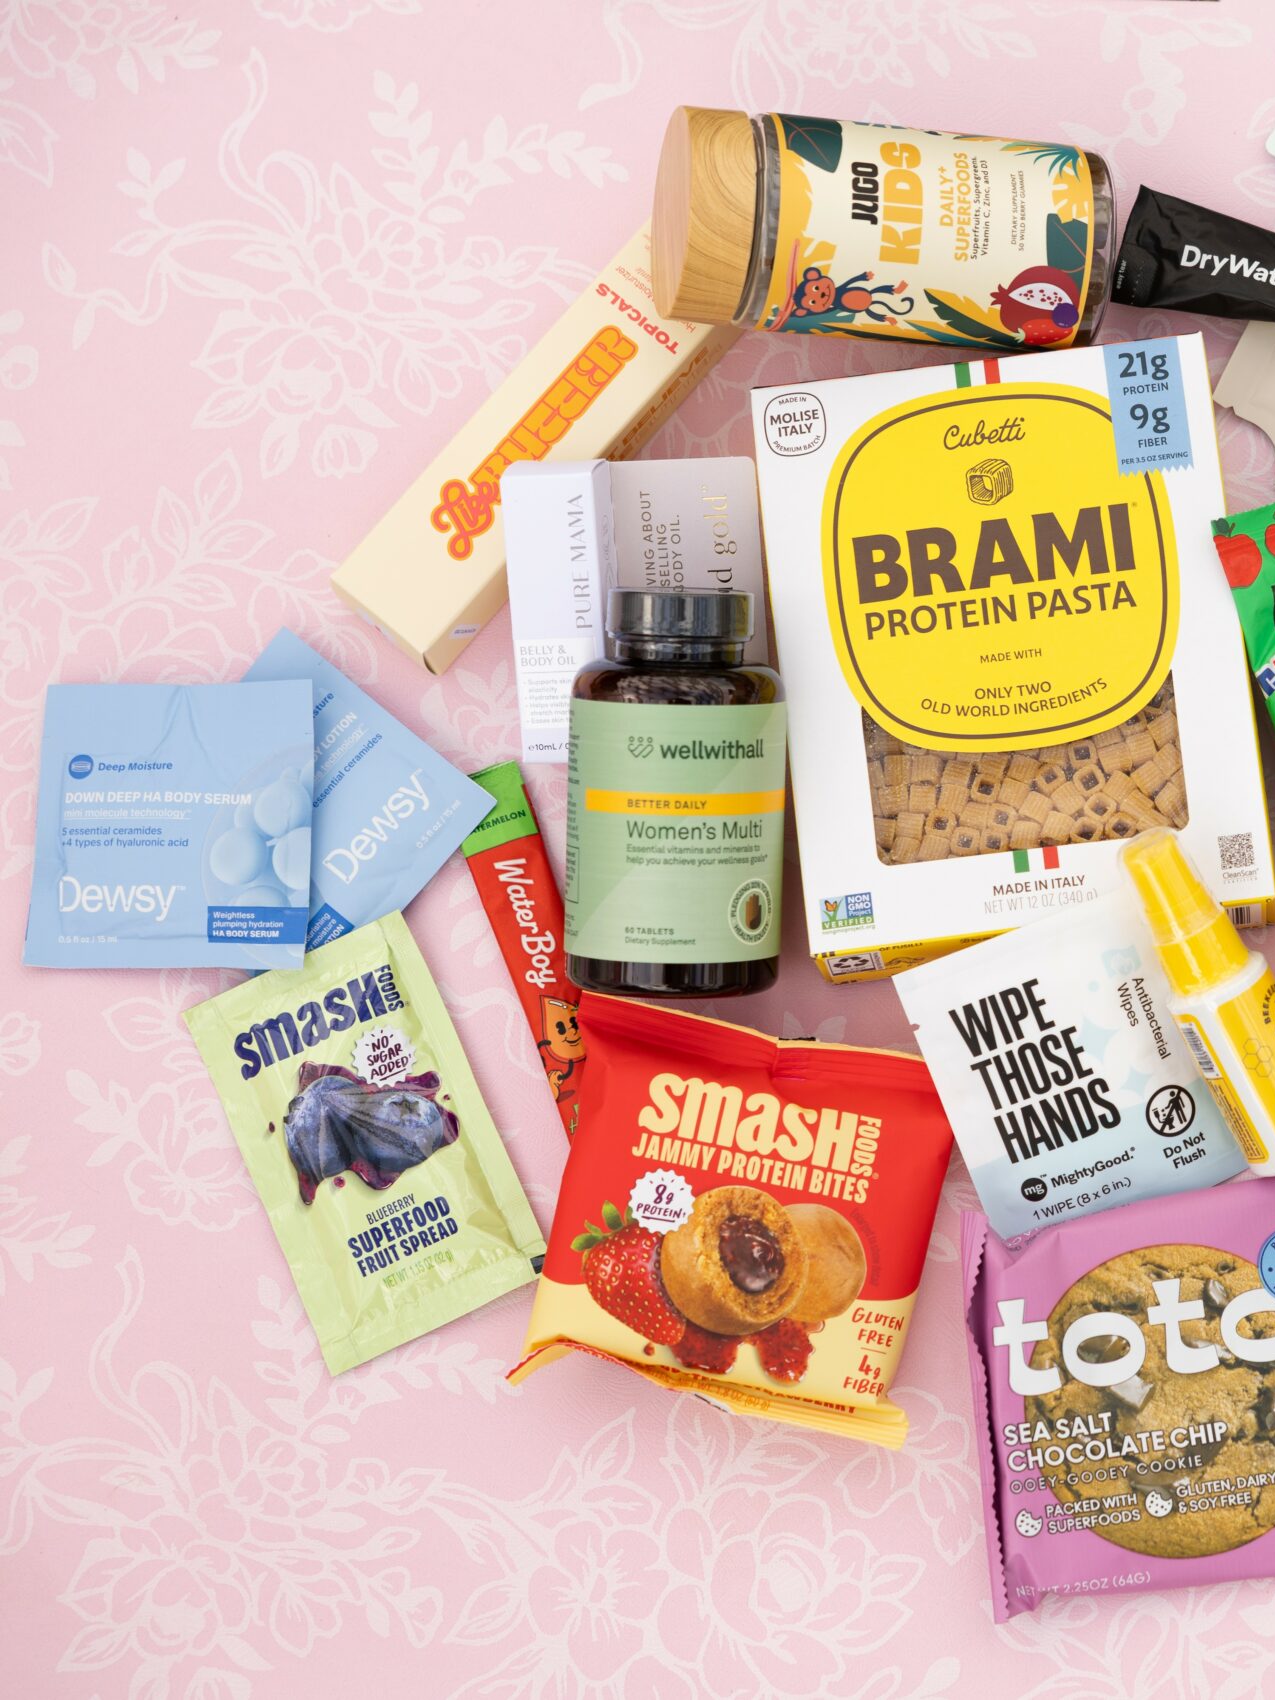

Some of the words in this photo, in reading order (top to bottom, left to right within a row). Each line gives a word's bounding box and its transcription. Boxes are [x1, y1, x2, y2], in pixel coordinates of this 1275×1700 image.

[851, 161, 879, 225] JUGO
[879, 141, 923, 265] KIDS
[953, 152, 971, 262] SUPERFOODS
[970, 206, 981, 260] Superfruits,
[1010, 219, 1018, 245] DIETARY
[595, 282, 680, 355] TOPICALS
[1118, 351, 1170, 380] 21g
[1122, 381, 1169, 396] PROTEIN
[769, 409, 820, 427] MOLISE
[778, 423, 813, 438] ITALY
[943, 417, 1026, 451] Cubetti
[1129, 404, 1170, 433] 9g
[567, 494, 587, 562] MAMA
[640, 491, 653, 543] ABOUT
[851, 502, 1137, 606] BRAMI
[573, 568, 593, 629] PURE
[864, 594, 1017, 641] PROTEIN
[1026, 580, 1137, 620] PASTA
[521, 656, 550, 666] BODY
[955, 702, 1010, 717] WORLD
[1013, 677, 1108, 715] INGREDIENTS
[660, 739, 764, 759] wellwithall
[98, 762, 125, 772] Deep
[128, 761, 173, 771] Moisture
[312, 771, 345, 808] essential
[344, 731, 383, 773] ceramides
[65, 792, 104, 804] DOWN
[107, 792, 140, 803] DEEP
[164, 792, 202, 803] BODY
[204, 793, 252, 806] SERUM
[627, 799, 671, 809] BETTER
[675, 801, 706, 810] DAILY
[69, 826, 110, 836] essential
[113, 826, 162, 836] ceramides
[322, 768, 429, 885] Dewsy
[473, 809, 526, 833] TERMELON
[626, 820, 717, 840] Women's
[722, 820, 763, 839] Multi
[59, 876, 178, 922] Dewsy
[992, 881, 1029, 896] MADE
[373, 964, 405, 1012] FOODS
[1117, 982, 1138, 1027] Wipes
[949, 979, 1055, 1058] WIPE
[1132, 977, 1171, 1060] Antibacterial
[367, 1044, 403, 1065] SUGAR
[970, 1026, 1094, 1110] THOSE
[994, 1078, 1121, 1164] HANDS
[849, 1115, 882, 1177] FOODS
[1163, 1145, 1182, 1159] Do
[1183, 1132, 1206, 1150] Not
[1173, 1147, 1207, 1169] Flush
[632, 1133, 716, 1171] JAMMY
[717, 1154, 809, 1190] PROTEIN
[808, 1170, 869, 1203] BITES
[366, 1193, 415, 1224] BLUEBERRY
[1043, 1199, 1075, 1218] WIPE
[347, 1196, 450, 1258] SUPERFOOD
[357, 1246, 400, 1277] FRUIT
[399, 1217, 459, 1257] SPREAD
[851, 1307, 904, 1332] GLUTEN
[858, 1330, 892, 1347] FREE
[843, 1376, 884, 1397] FIBER
[1004, 1423, 1051, 1446] SEA
[1056, 1412, 1112, 1439] SALT
[1008, 1429, 1166, 1473] CHOCOLATE
[1169, 1421, 1229, 1450] CHIP
[1010, 1465, 1130, 1494] OOEY-GOOEY
[1137, 1455, 1203, 1475] COOKIE
[1045, 1499, 1097, 1518] PACKED
[1099, 1493, 1138, 1510] WITH
[1220, 1492, 1253, 1507] FREE
[1048, 1509, 1141, 1534] SUPERFOODS
